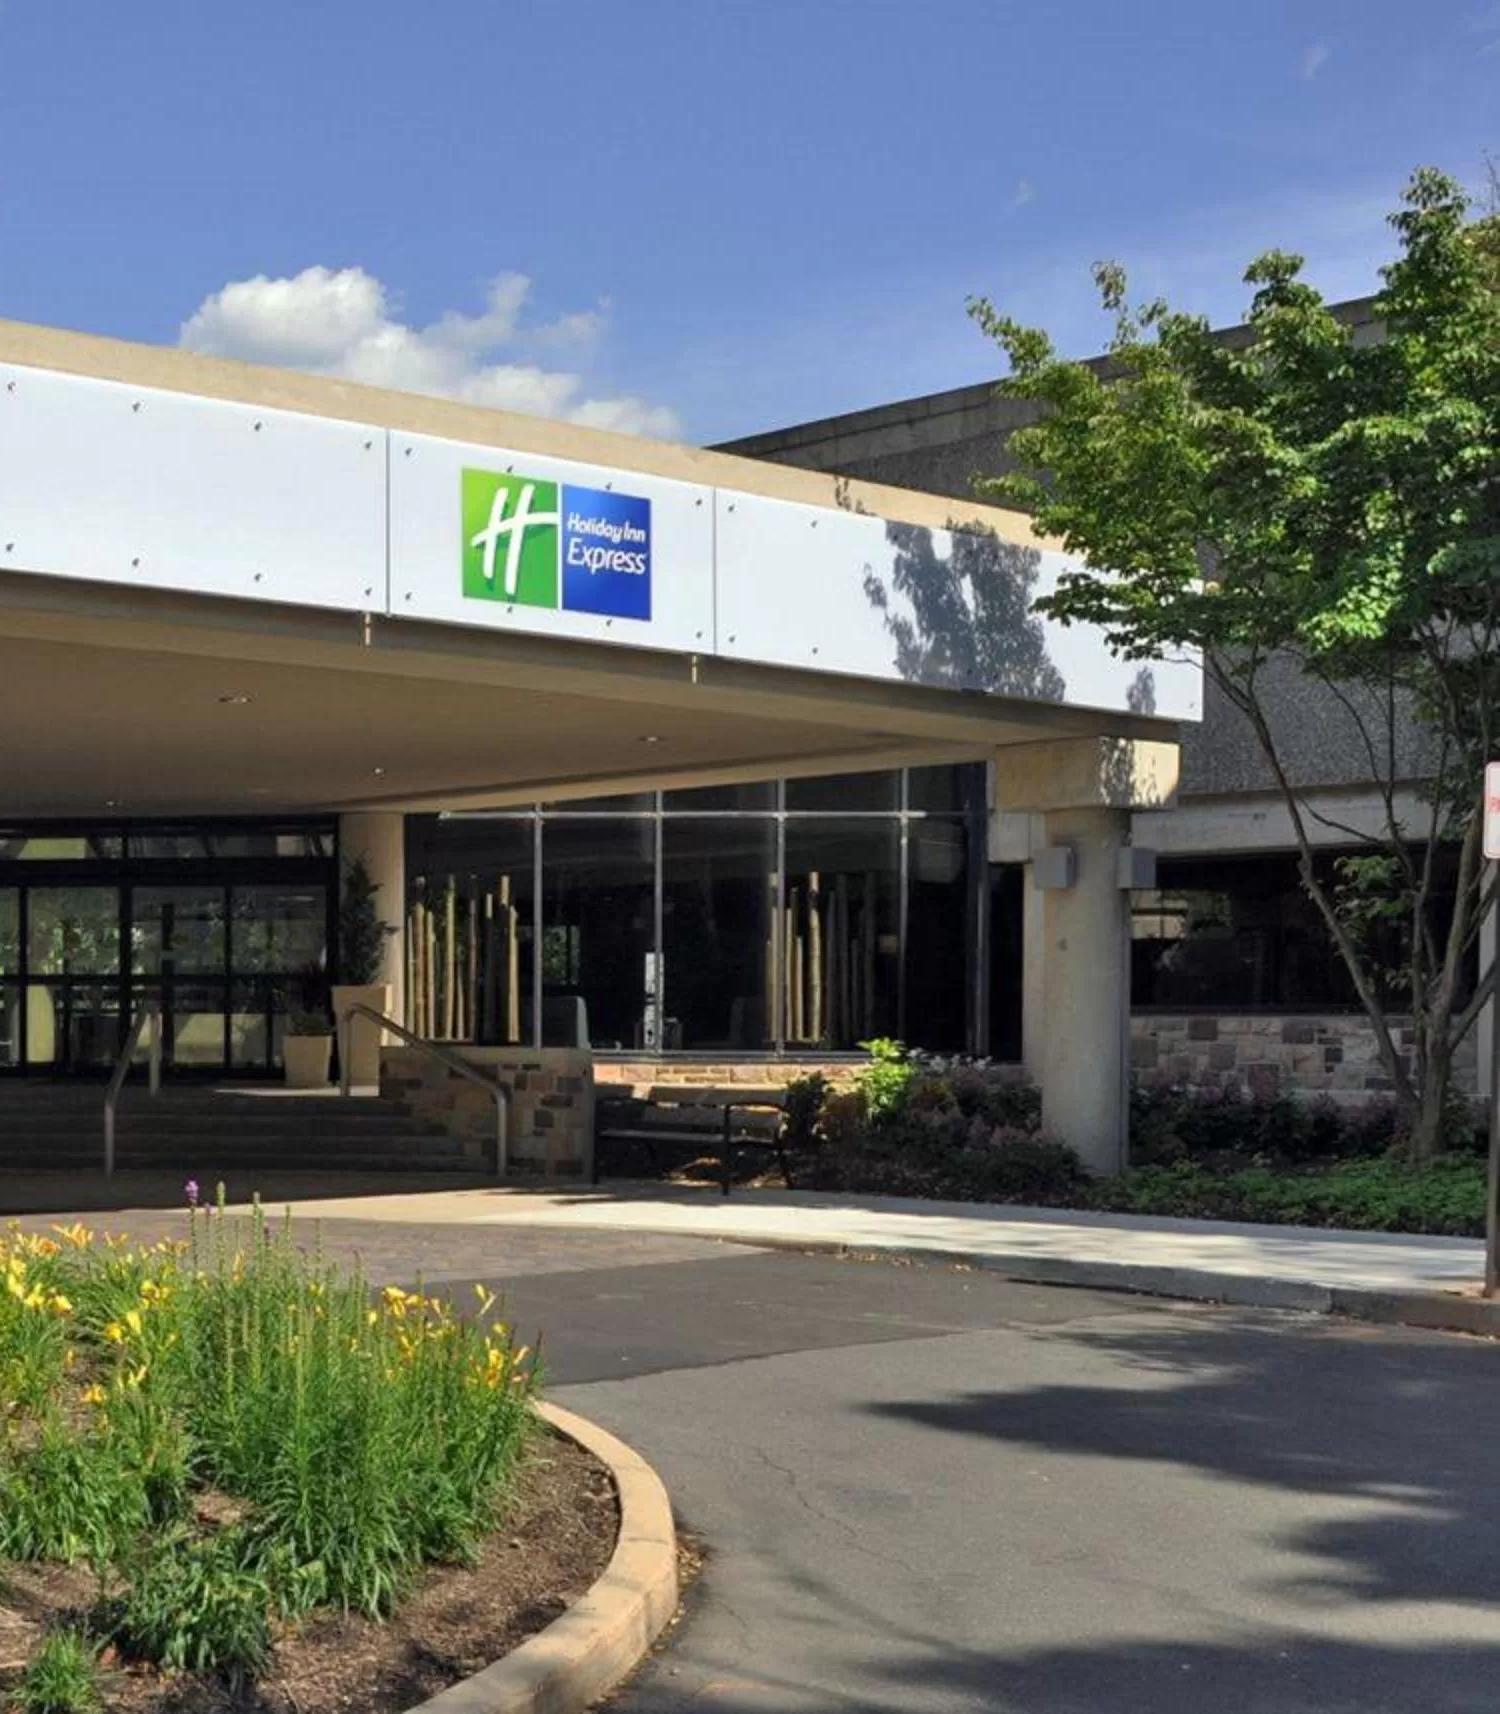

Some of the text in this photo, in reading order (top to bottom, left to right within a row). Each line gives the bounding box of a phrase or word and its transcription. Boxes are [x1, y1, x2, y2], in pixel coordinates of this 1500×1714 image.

[567, 511, 646, 543] Holiday Inn
[567, 537, 647, 575] Express
